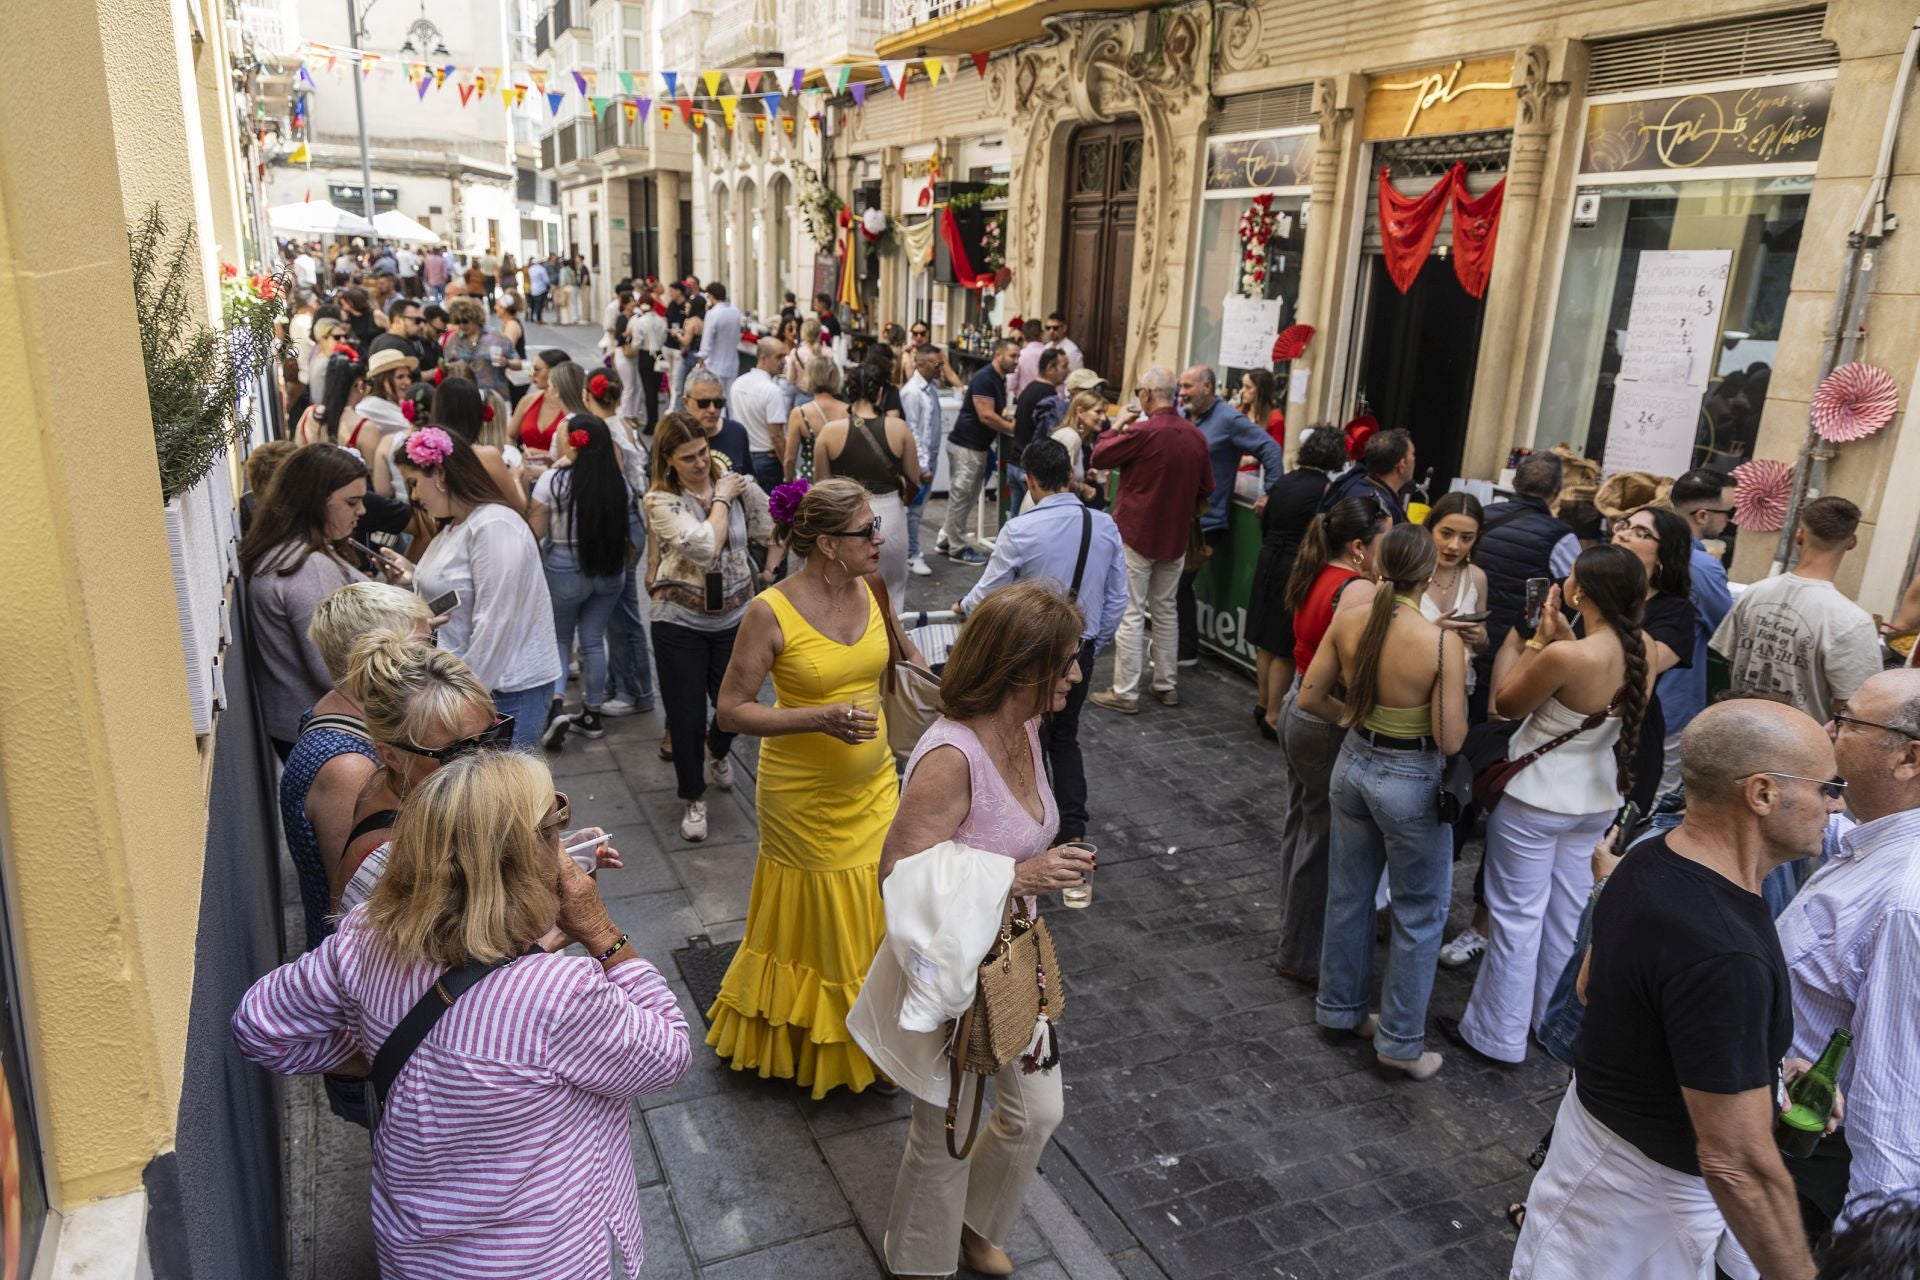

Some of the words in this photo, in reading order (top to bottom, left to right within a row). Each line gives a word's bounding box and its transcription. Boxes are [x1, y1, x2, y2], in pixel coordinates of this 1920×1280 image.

[1748, 115, 1823, 156] Music
[1757, 615, 1772, 628] The
[1757, 629, 1778, 642] Hote
